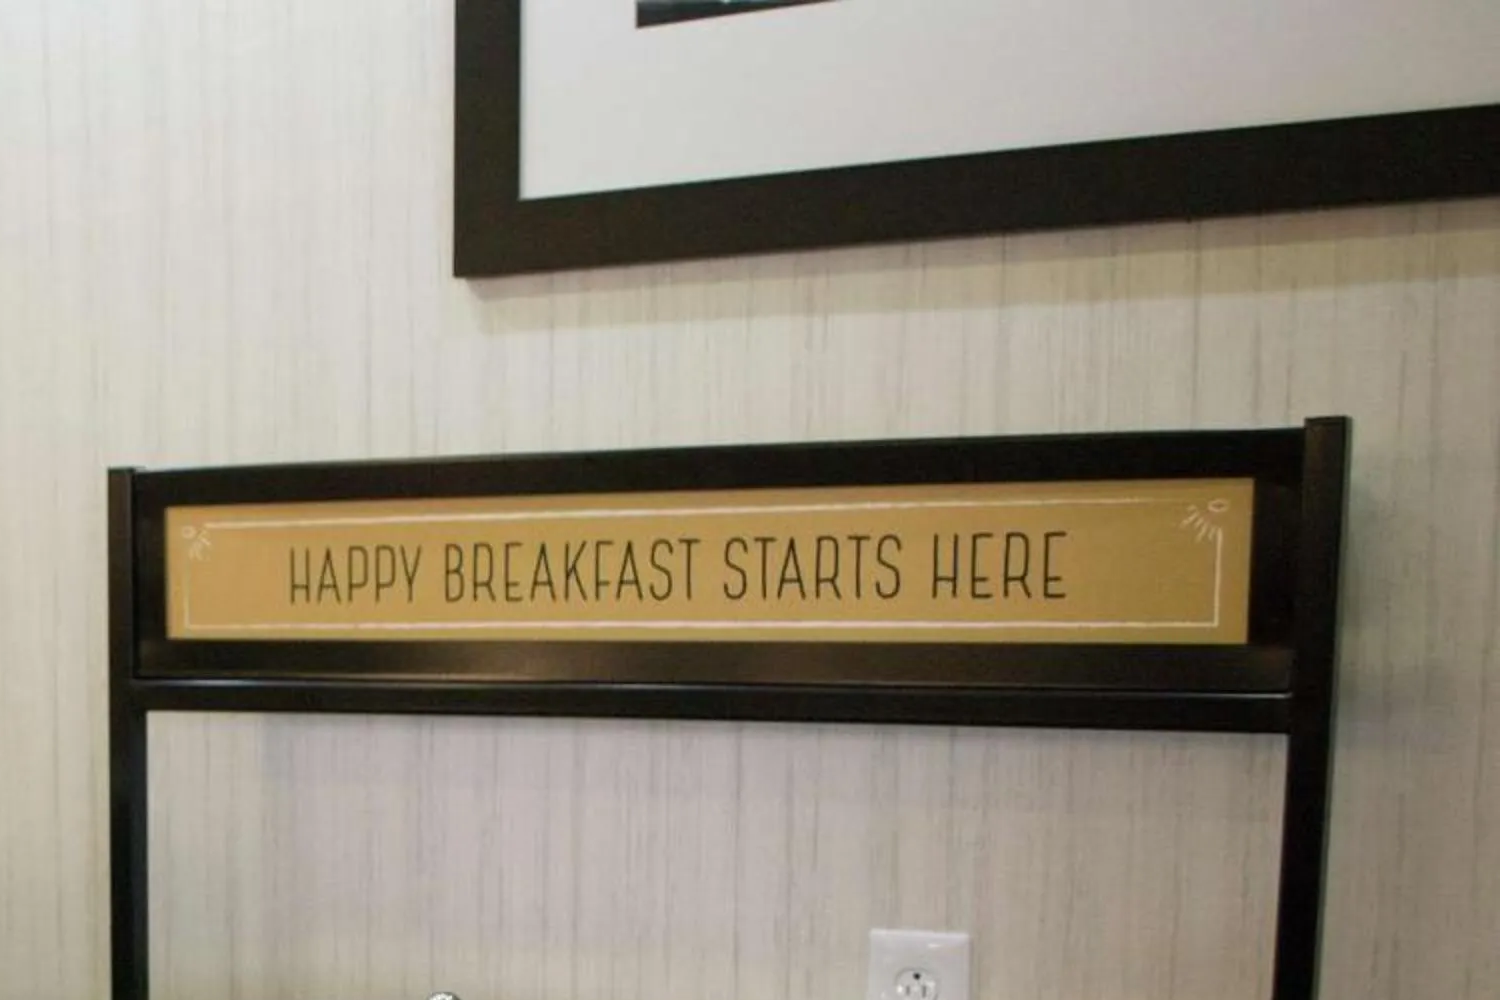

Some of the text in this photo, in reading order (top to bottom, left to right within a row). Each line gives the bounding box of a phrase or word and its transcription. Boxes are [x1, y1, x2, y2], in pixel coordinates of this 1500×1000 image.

[289, 531, 1068, 604] HAPPY BREAKFAST STARTS HERE
